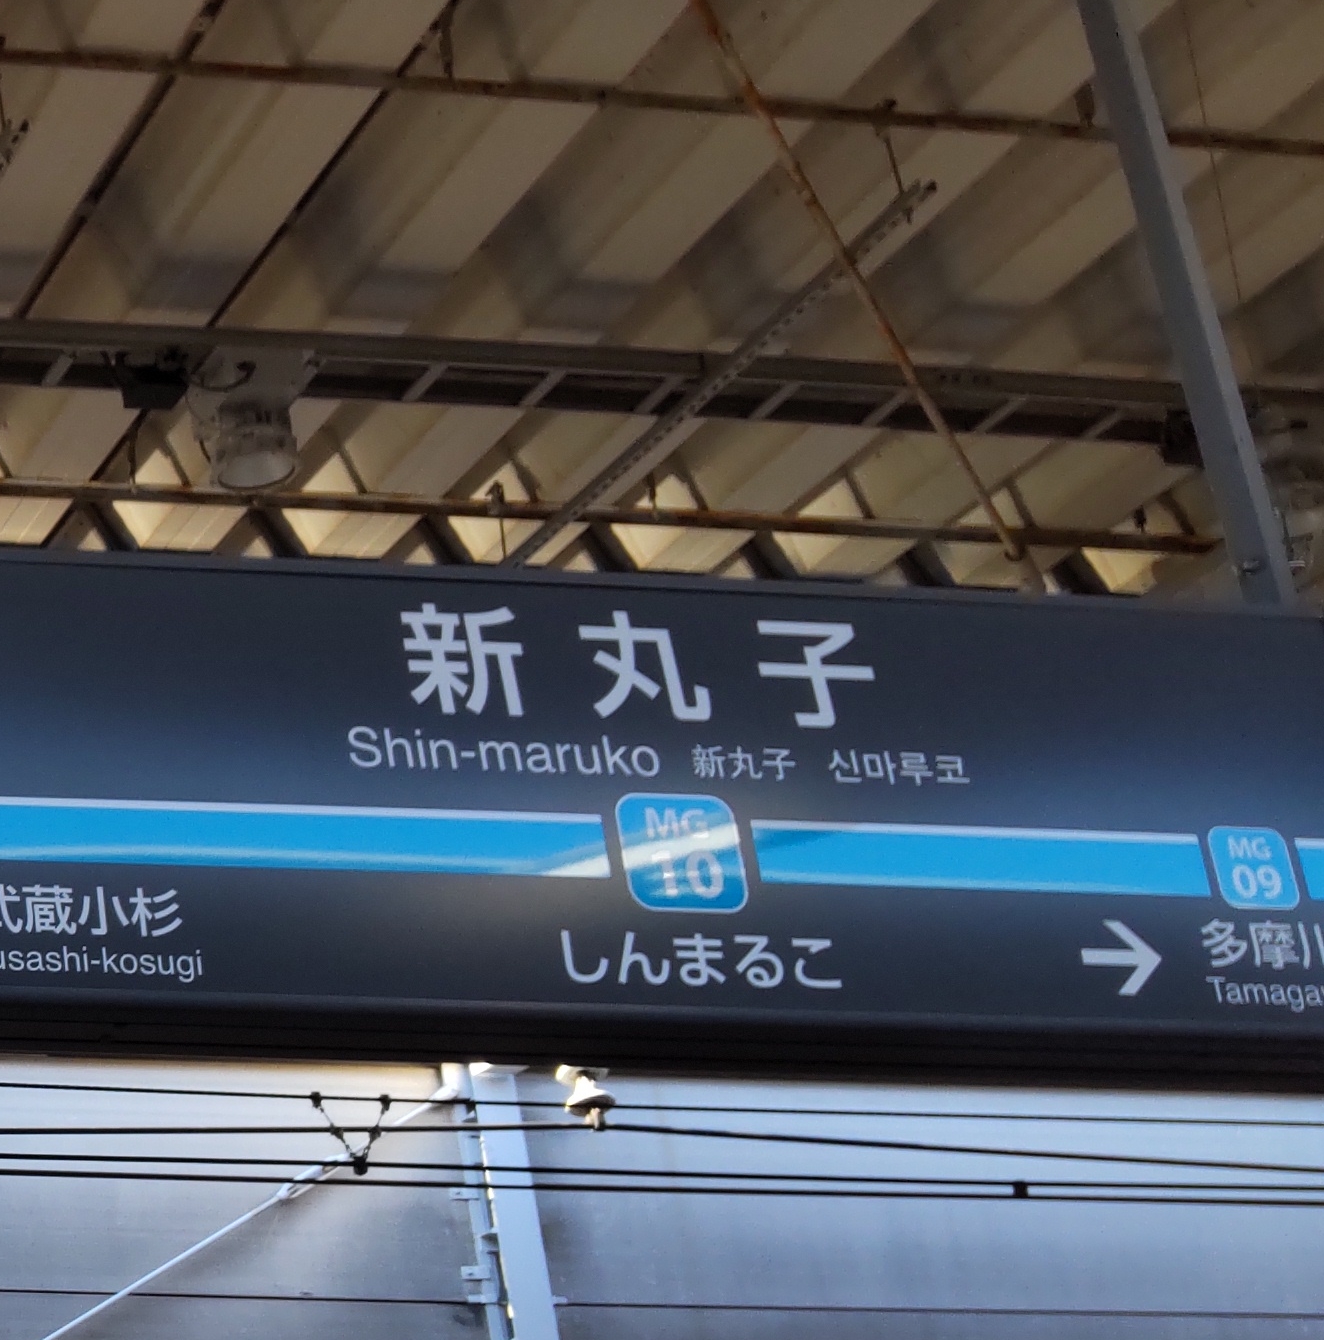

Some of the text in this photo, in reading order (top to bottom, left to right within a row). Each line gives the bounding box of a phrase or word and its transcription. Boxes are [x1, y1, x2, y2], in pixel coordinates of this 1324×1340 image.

[400, 603, 875, 729] 新丸子
[347, 726, 661, 778] Shin-maruko
[691, 744, 796, 781] 新丸子
[827, 748, 971, 786] 신마루코
[646, 807, 709, 839] MG
[1228, 834, 1272, 860] MG
[654, 848, 725, 900] 10
[1232, 864, 1282, 899] 09
[560, 929, 843, 989] しんまるこ
[1205, 975, 1324, 1013] Tamaga
